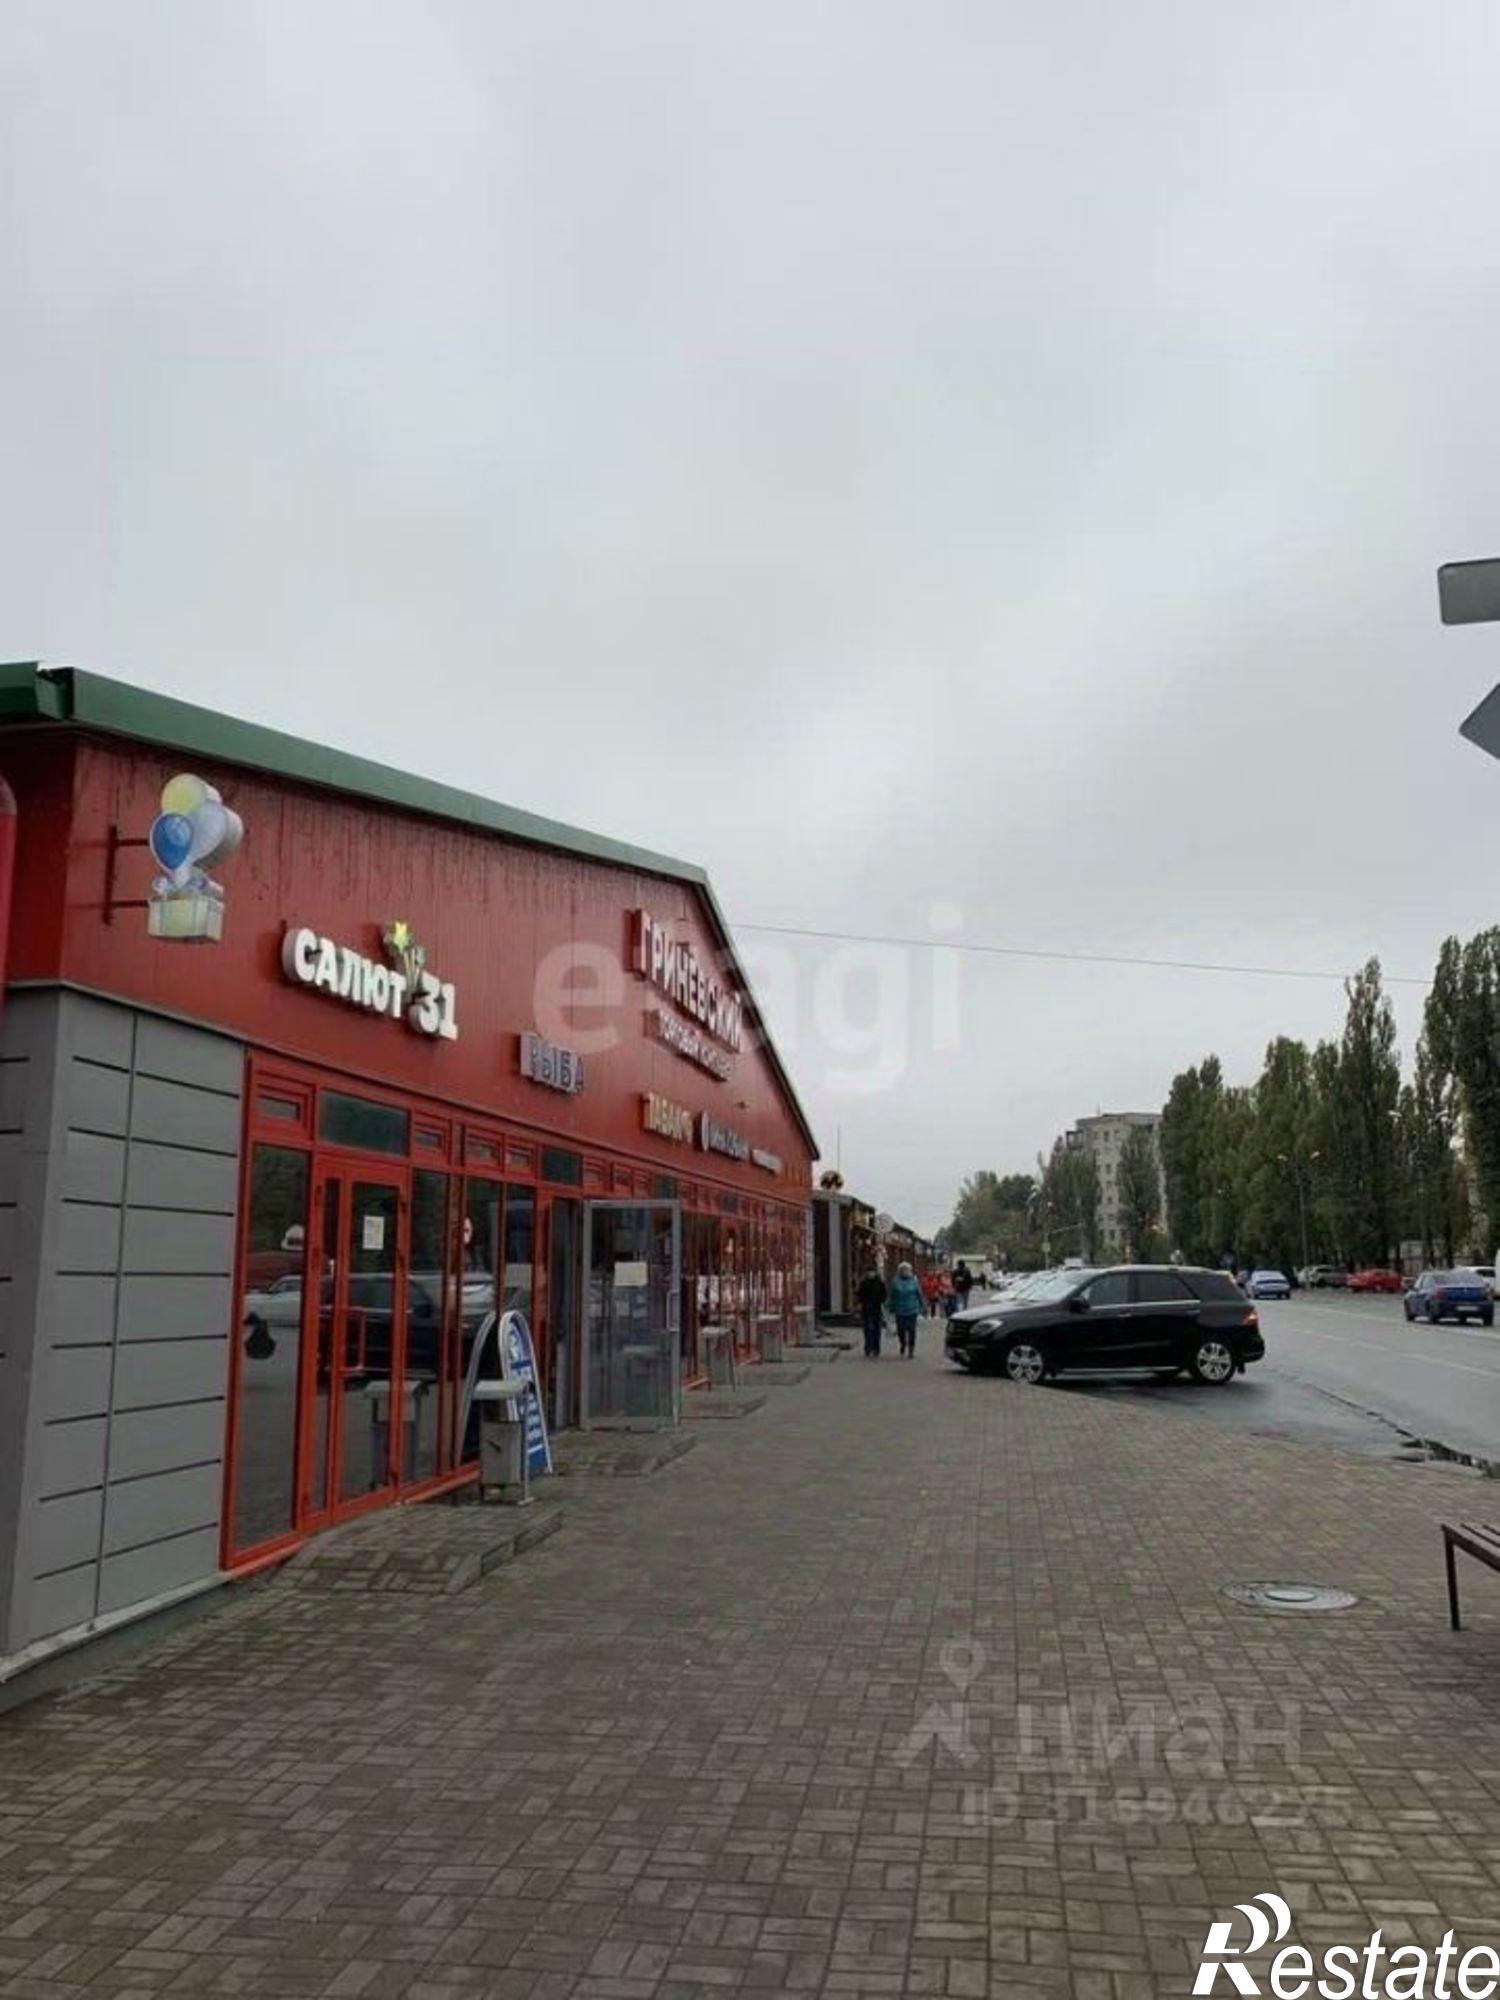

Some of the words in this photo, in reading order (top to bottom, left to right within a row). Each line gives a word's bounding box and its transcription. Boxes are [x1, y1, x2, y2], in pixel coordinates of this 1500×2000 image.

[292, 926, 407, 1019] САЛЮТ
[412, 973, 459, 1041] 31
[526, 1034, 584, 1093] РЫБА
